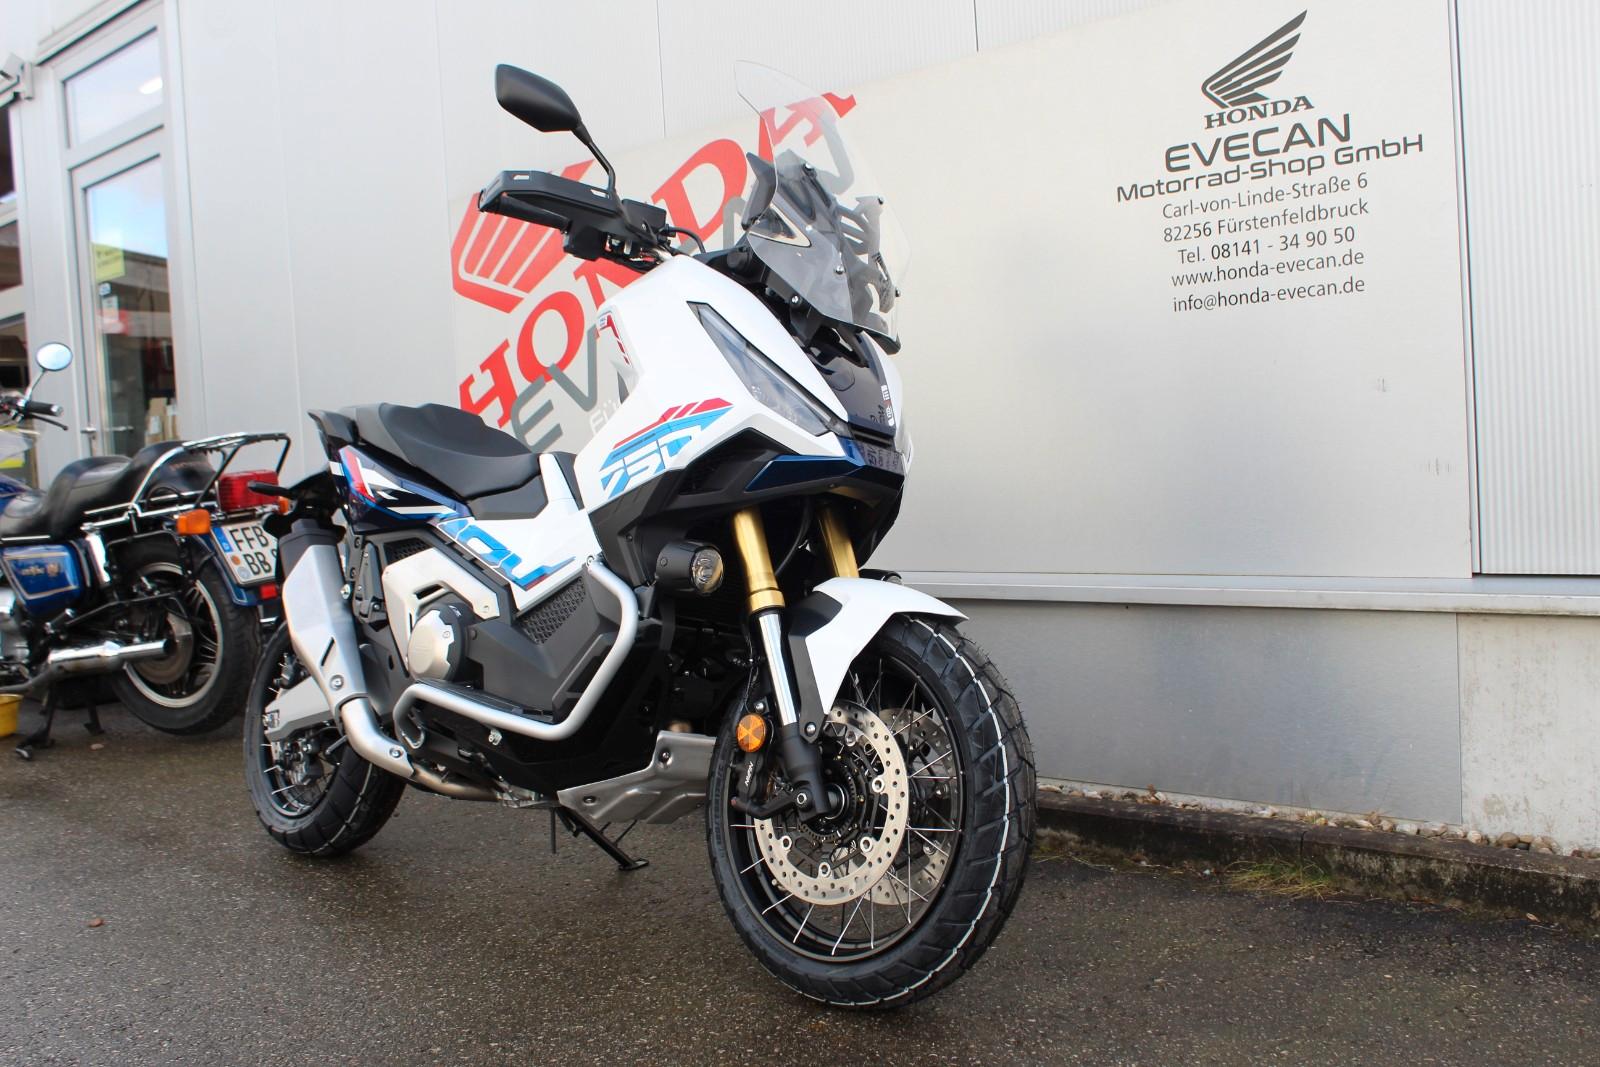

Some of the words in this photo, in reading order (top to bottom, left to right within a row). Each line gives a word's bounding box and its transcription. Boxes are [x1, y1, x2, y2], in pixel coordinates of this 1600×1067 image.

[1203, 95, 1315, 130] HONDA
[1164, 112, 1351, 173] EVECAN
[1116, 154, 1326, 203] Motorrad-Shop
[1334, 133, 1424, 166] GmbH
[1162, 175, 1351, 219] Carl-von-Linde-Straße
[1357, 171, 1368, 189] 6
[1163, 221, 1212, 243] 82256
[1217, 197, 1369, 236] Fürstenfeldbruck
[1177, 245, 1206, 265] Tel.
[1210, 238, 1260, 261] 08141
[1279, 233, 1301, 252] 34
[1305, 229, 1328, 248] 90
[1333, 225, 1355, 245] 50
[1171, 247, 1365, 287] www.honda-evecan.de
[1173, 275, 1365, 313] info@honda-evecan.de
[229, 526, 269, 551] FFB
